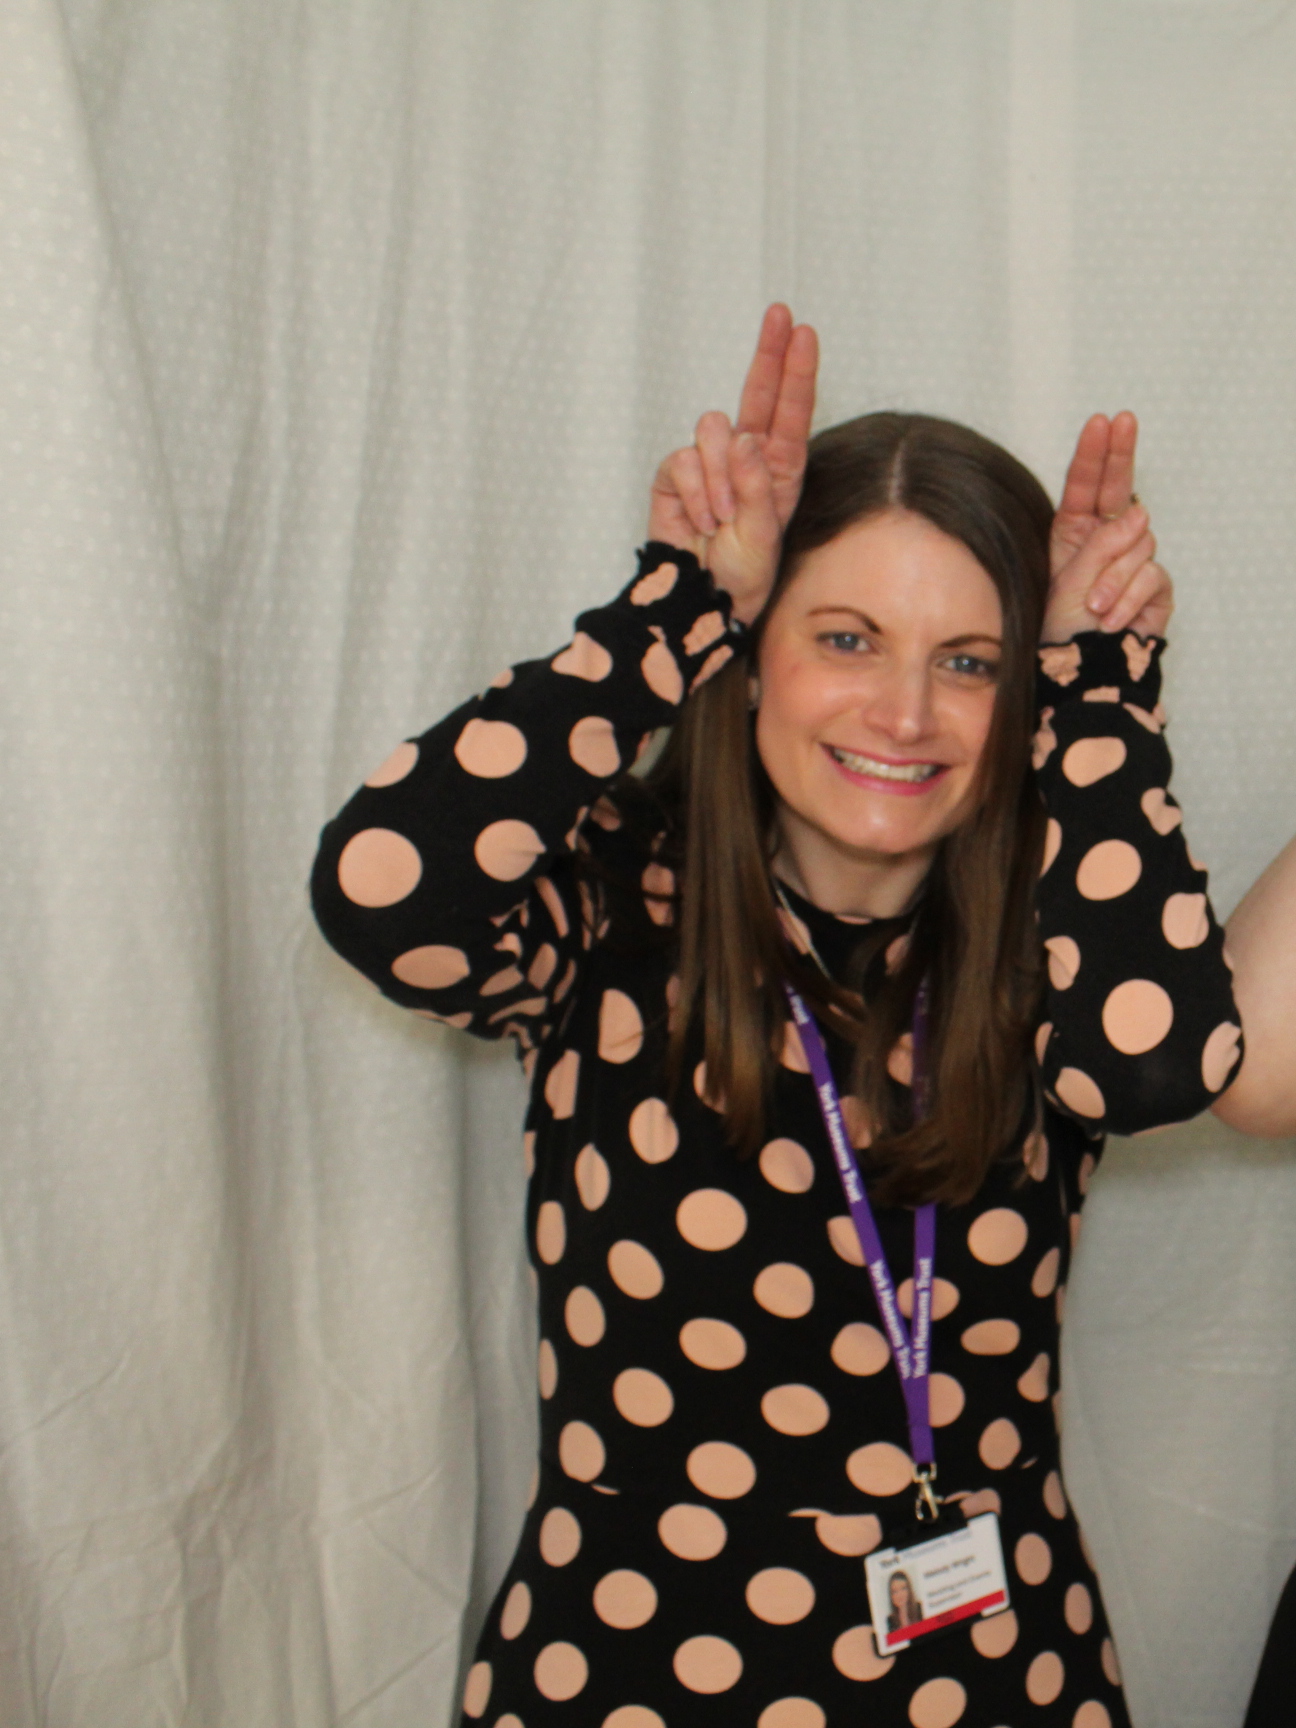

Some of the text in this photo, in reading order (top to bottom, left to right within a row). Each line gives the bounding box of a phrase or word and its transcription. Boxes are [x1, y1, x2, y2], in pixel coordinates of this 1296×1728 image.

[819, 1081, 863, 1204] York Museums Trust
[870, 1259, 889, 1290] York
[879, 1289, 904, 1348] Museums
[912, 1258, 932, 1379] York Museums Trust
